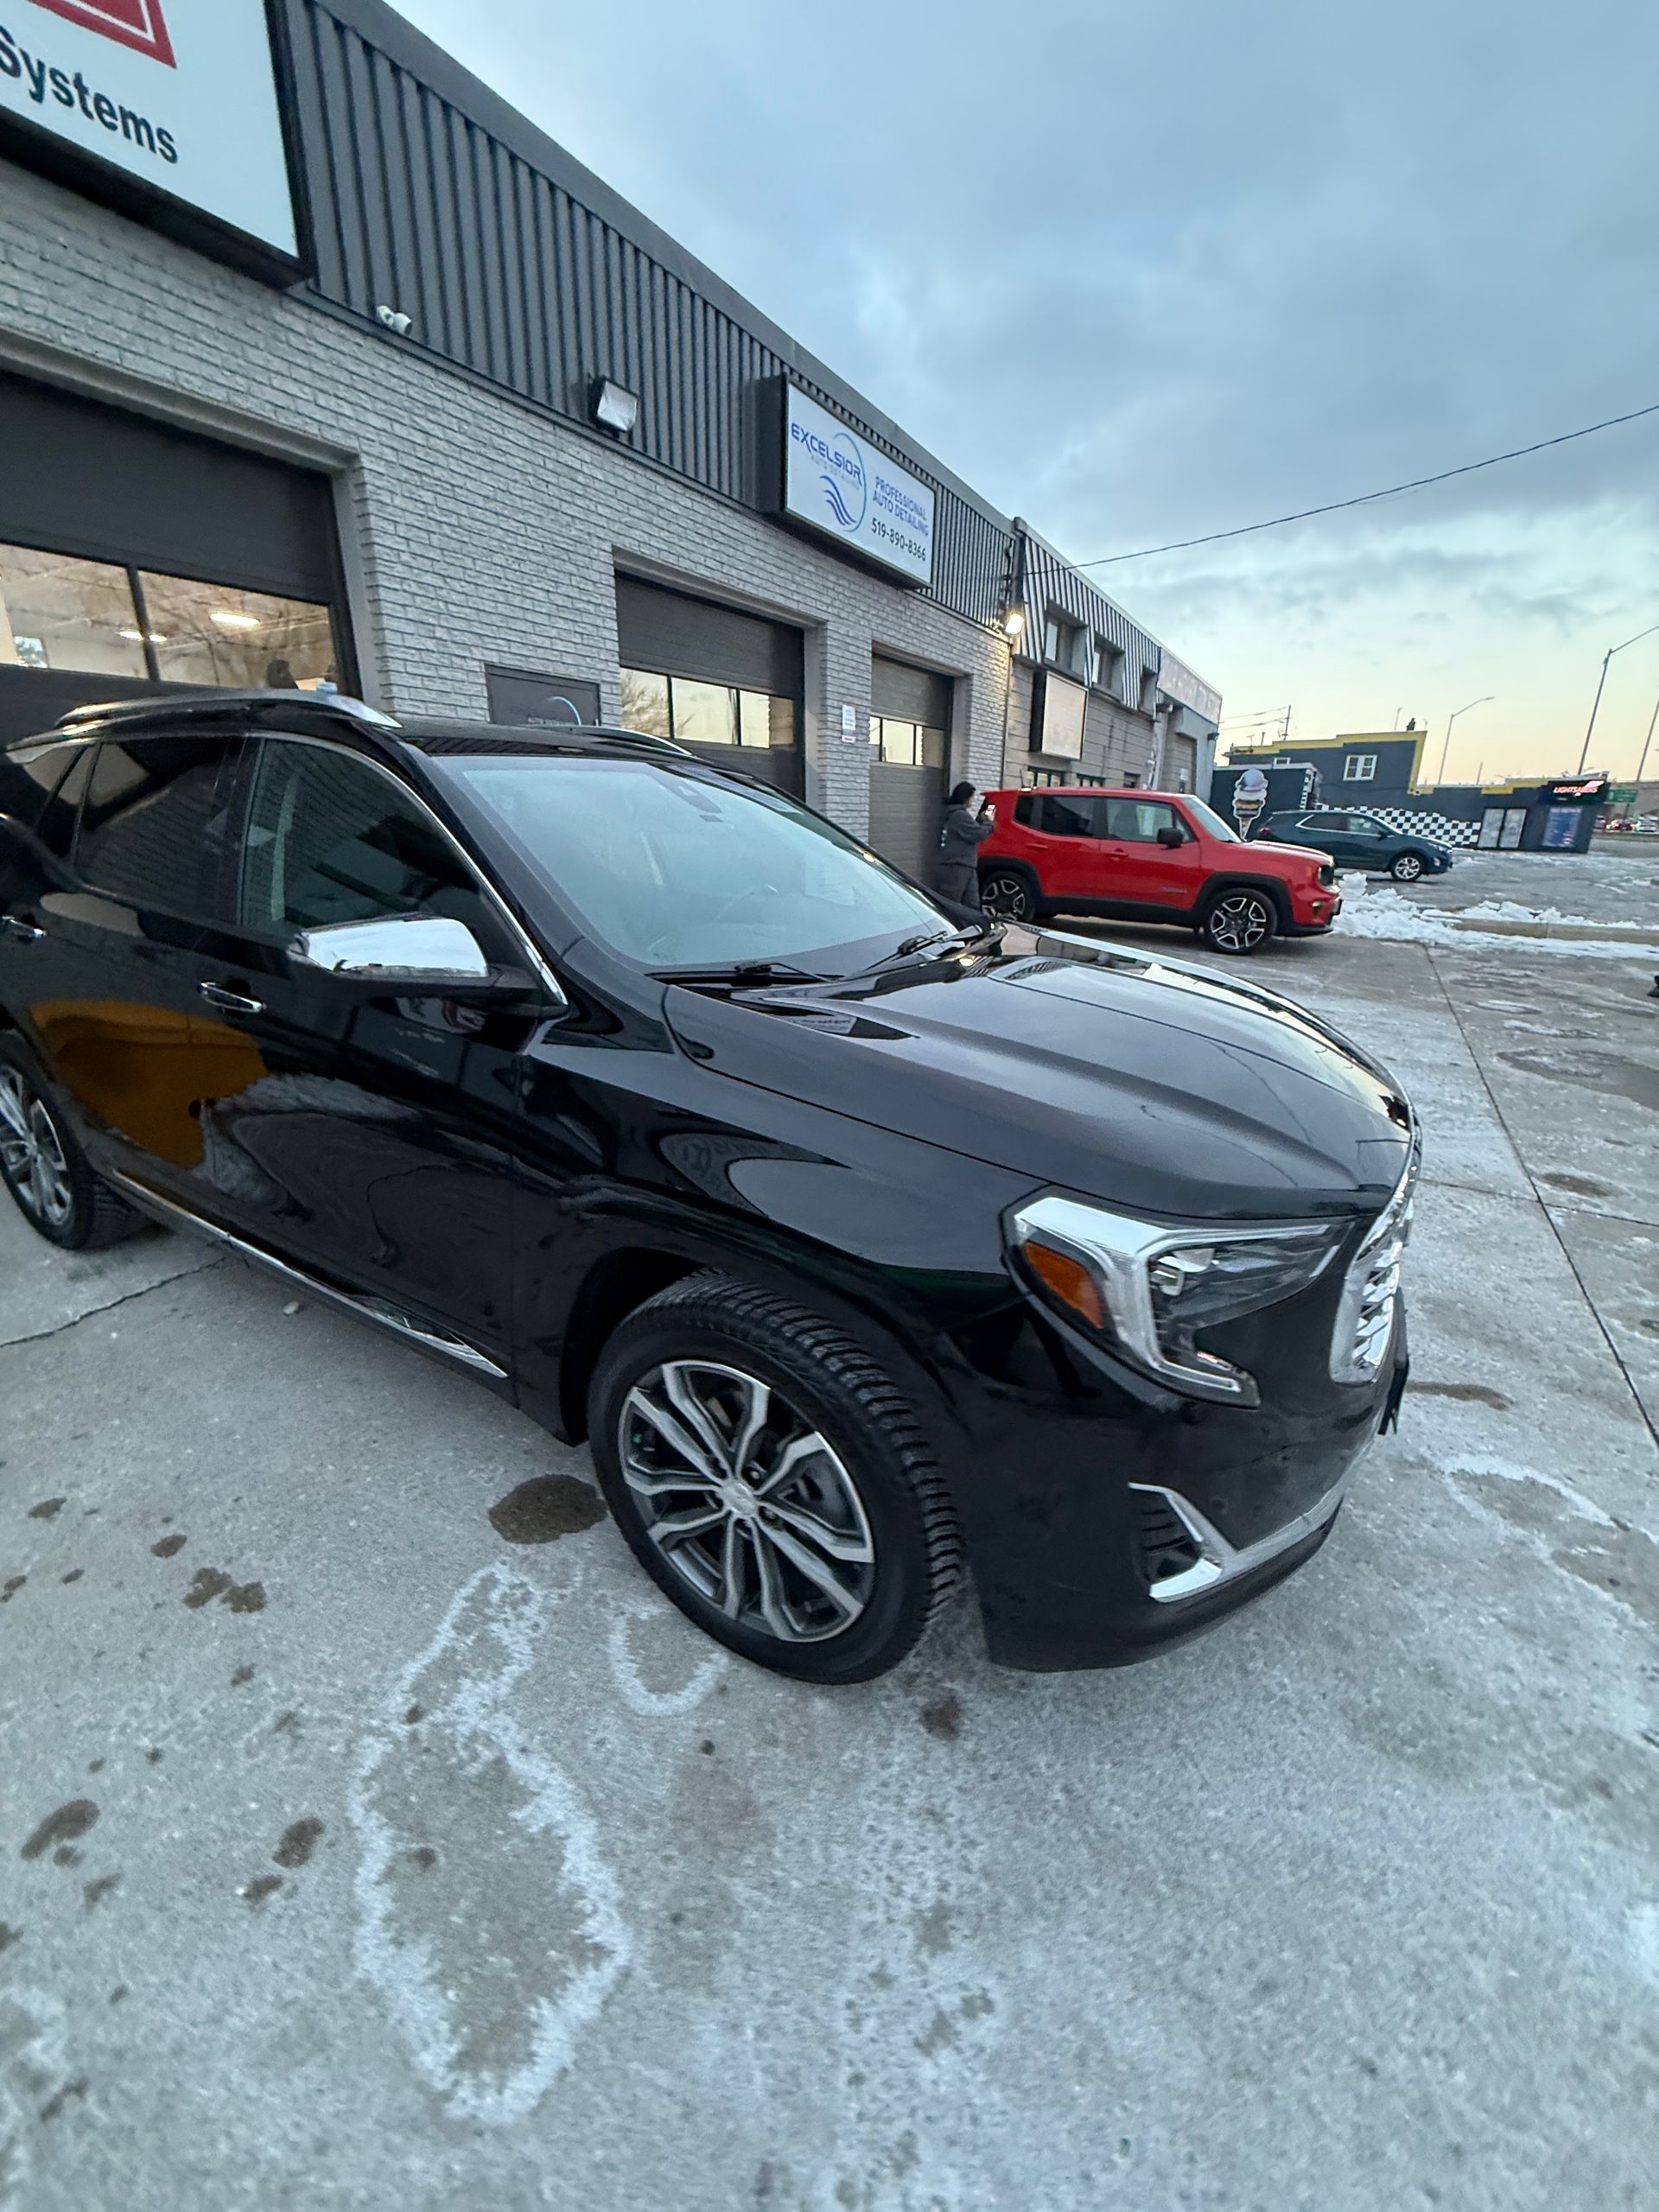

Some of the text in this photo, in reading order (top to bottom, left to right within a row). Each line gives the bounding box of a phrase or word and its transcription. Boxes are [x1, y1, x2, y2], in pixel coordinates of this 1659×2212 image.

[0, 22, 178, 164] Systems
[791, 423, 862, 486] EXCELSIOR
[873, 490, 929, 537] AUTO DETAILING
[874, 476, 927, 521] PROFESSIONAL
[871, 518, 926, 562] 519-890-8366
